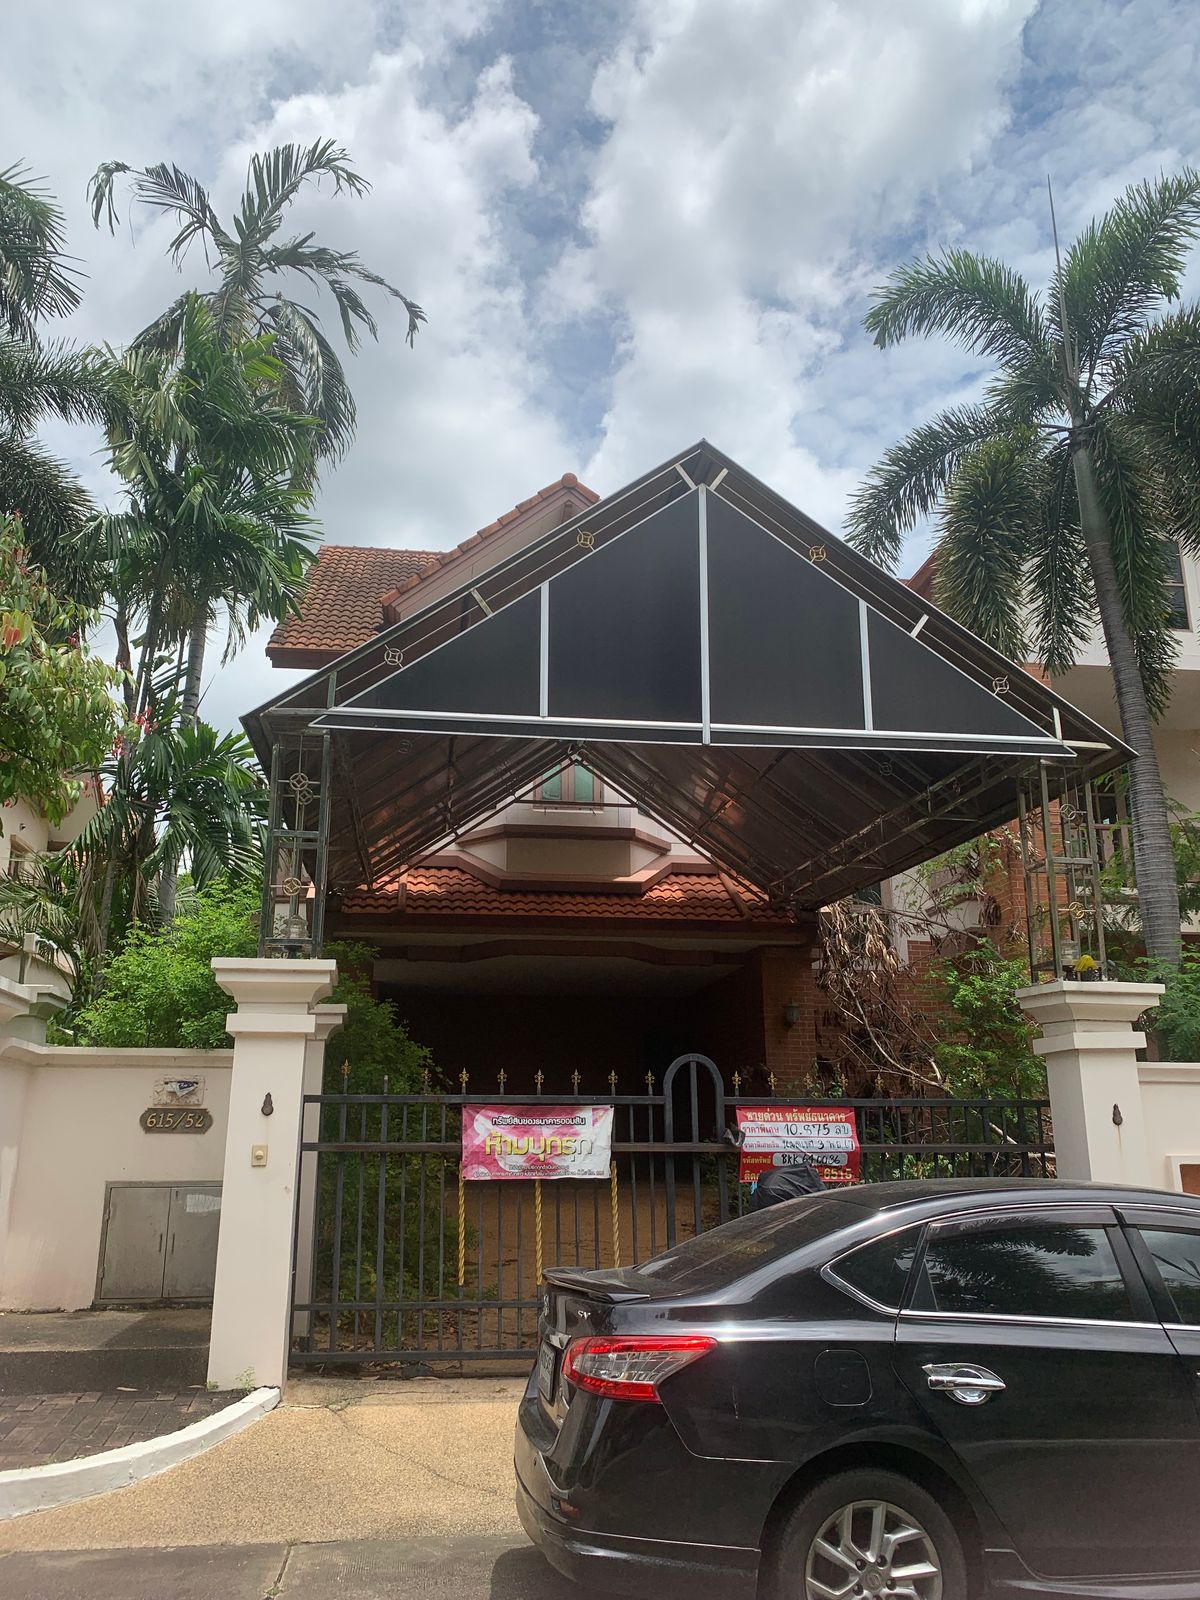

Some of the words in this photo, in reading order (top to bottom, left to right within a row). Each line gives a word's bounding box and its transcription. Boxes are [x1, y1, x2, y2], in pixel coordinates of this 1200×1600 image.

[146, 1111, 205, 1129] 615/52
[746, 1108, 783, 1121] ขายด่วน
[785, 1108, 846, 1122] ทรัพย์ธนาคาร
[485, 1130, 594, 1162] ห้ามบุกรุก
